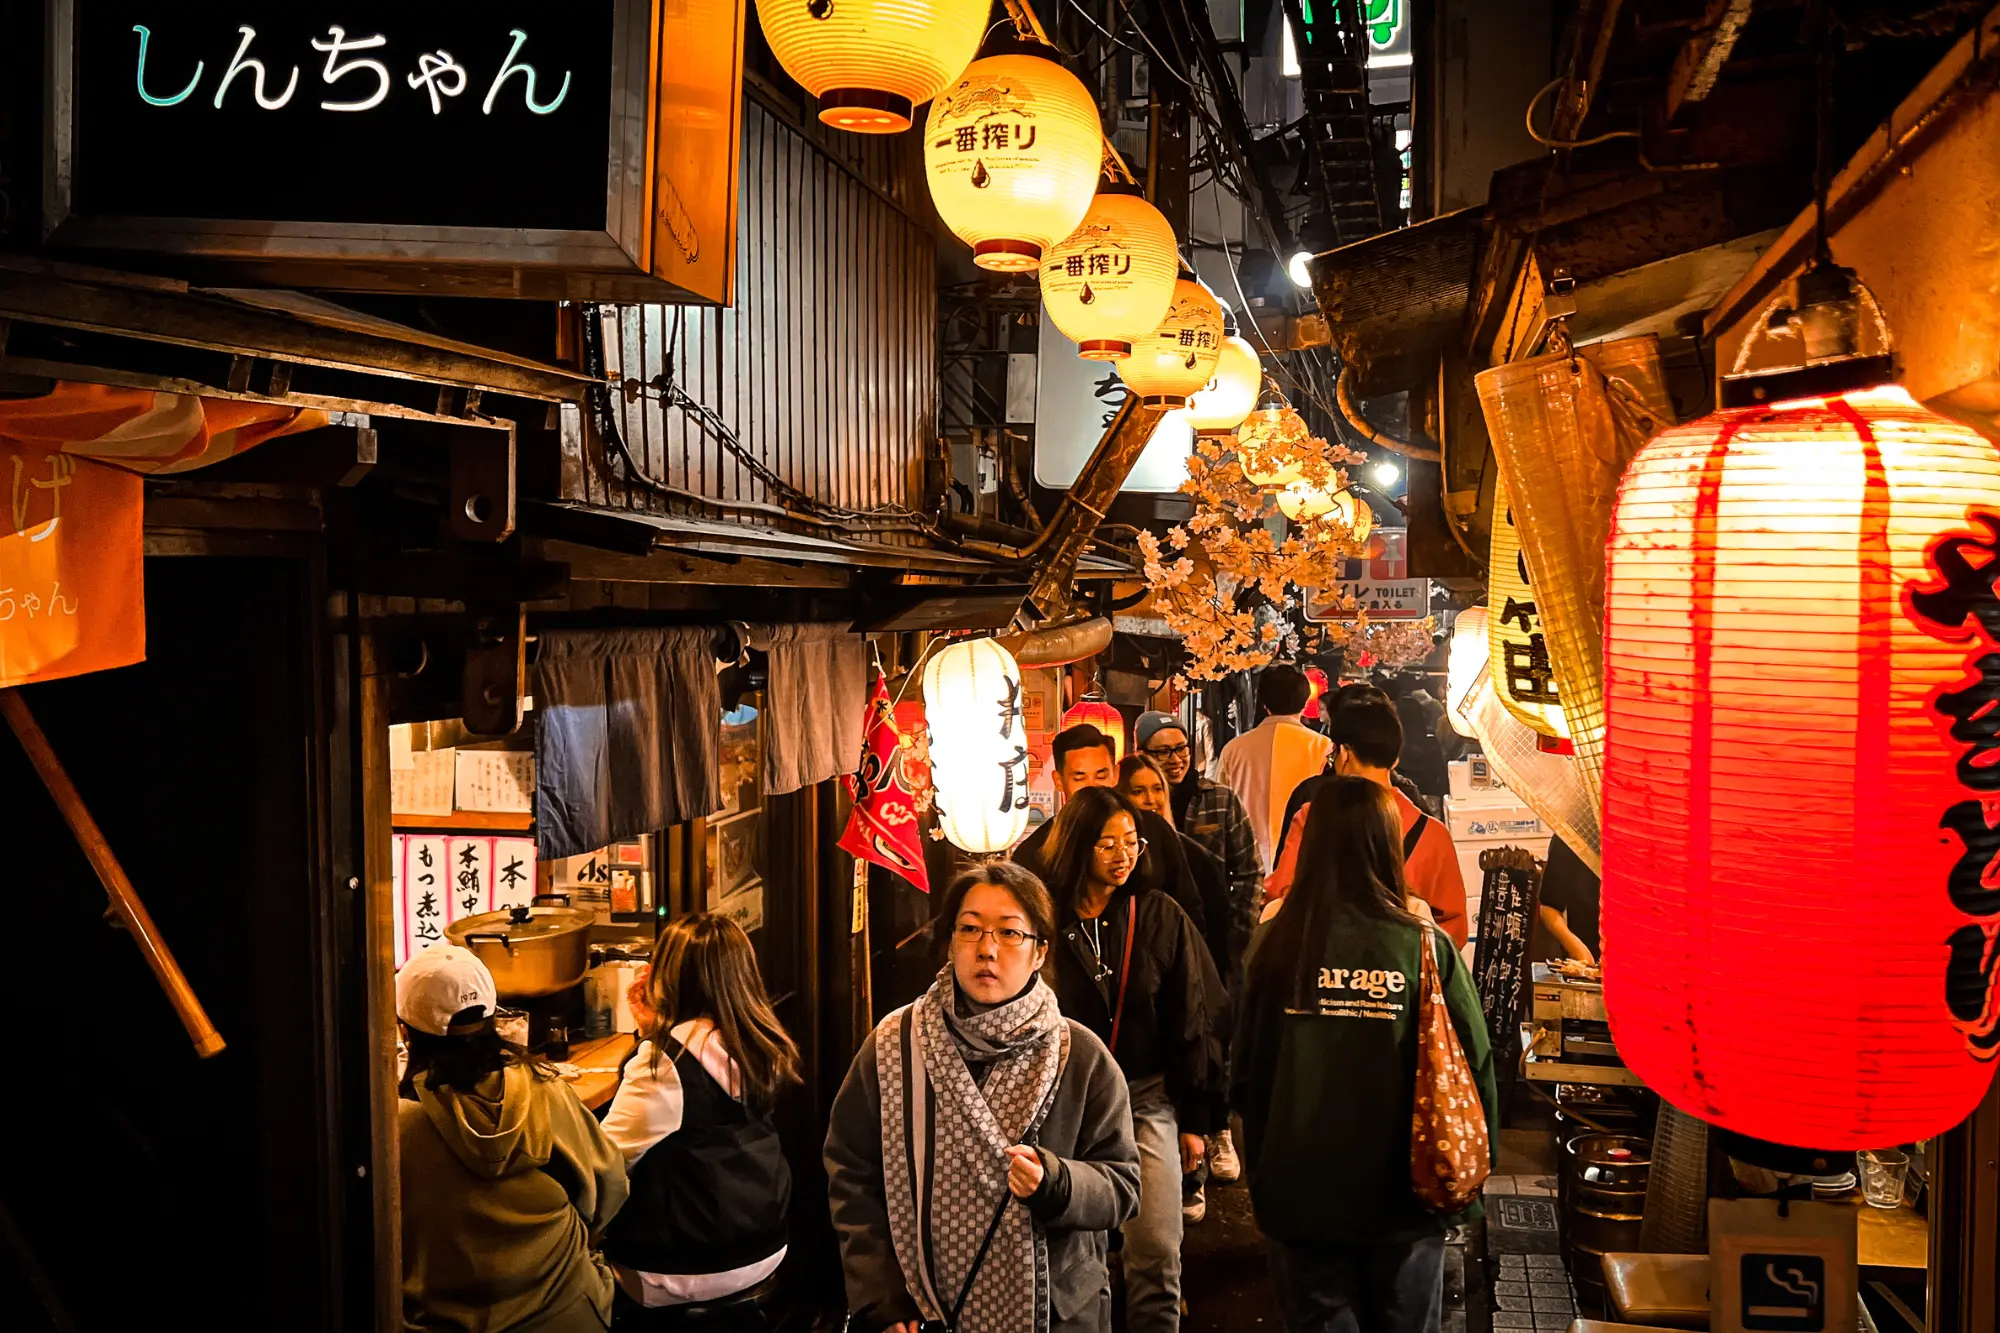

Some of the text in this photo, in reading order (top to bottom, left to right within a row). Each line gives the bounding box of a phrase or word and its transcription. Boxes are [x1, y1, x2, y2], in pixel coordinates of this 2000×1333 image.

[132, 24, 571, 116] しんちゃん
[934, 122, 1036, 153] 一番搾り
[1049, 253, 1131, 277] 一番搾り
[1159, 328, 1220, 350] 一番搾り
[1375, 587, 1416, 598] TOILET
[456, 843, 480, 917] 本鮪中
[414, 844, 441, 948] もつ煮込
[1317, 967, 1406, 999] arage
[1344, 999, 1360, 1007] and
[1377, 1001, 1404, 1011] Nature
[1363, 1009, 1397, 1020] Neolithic
